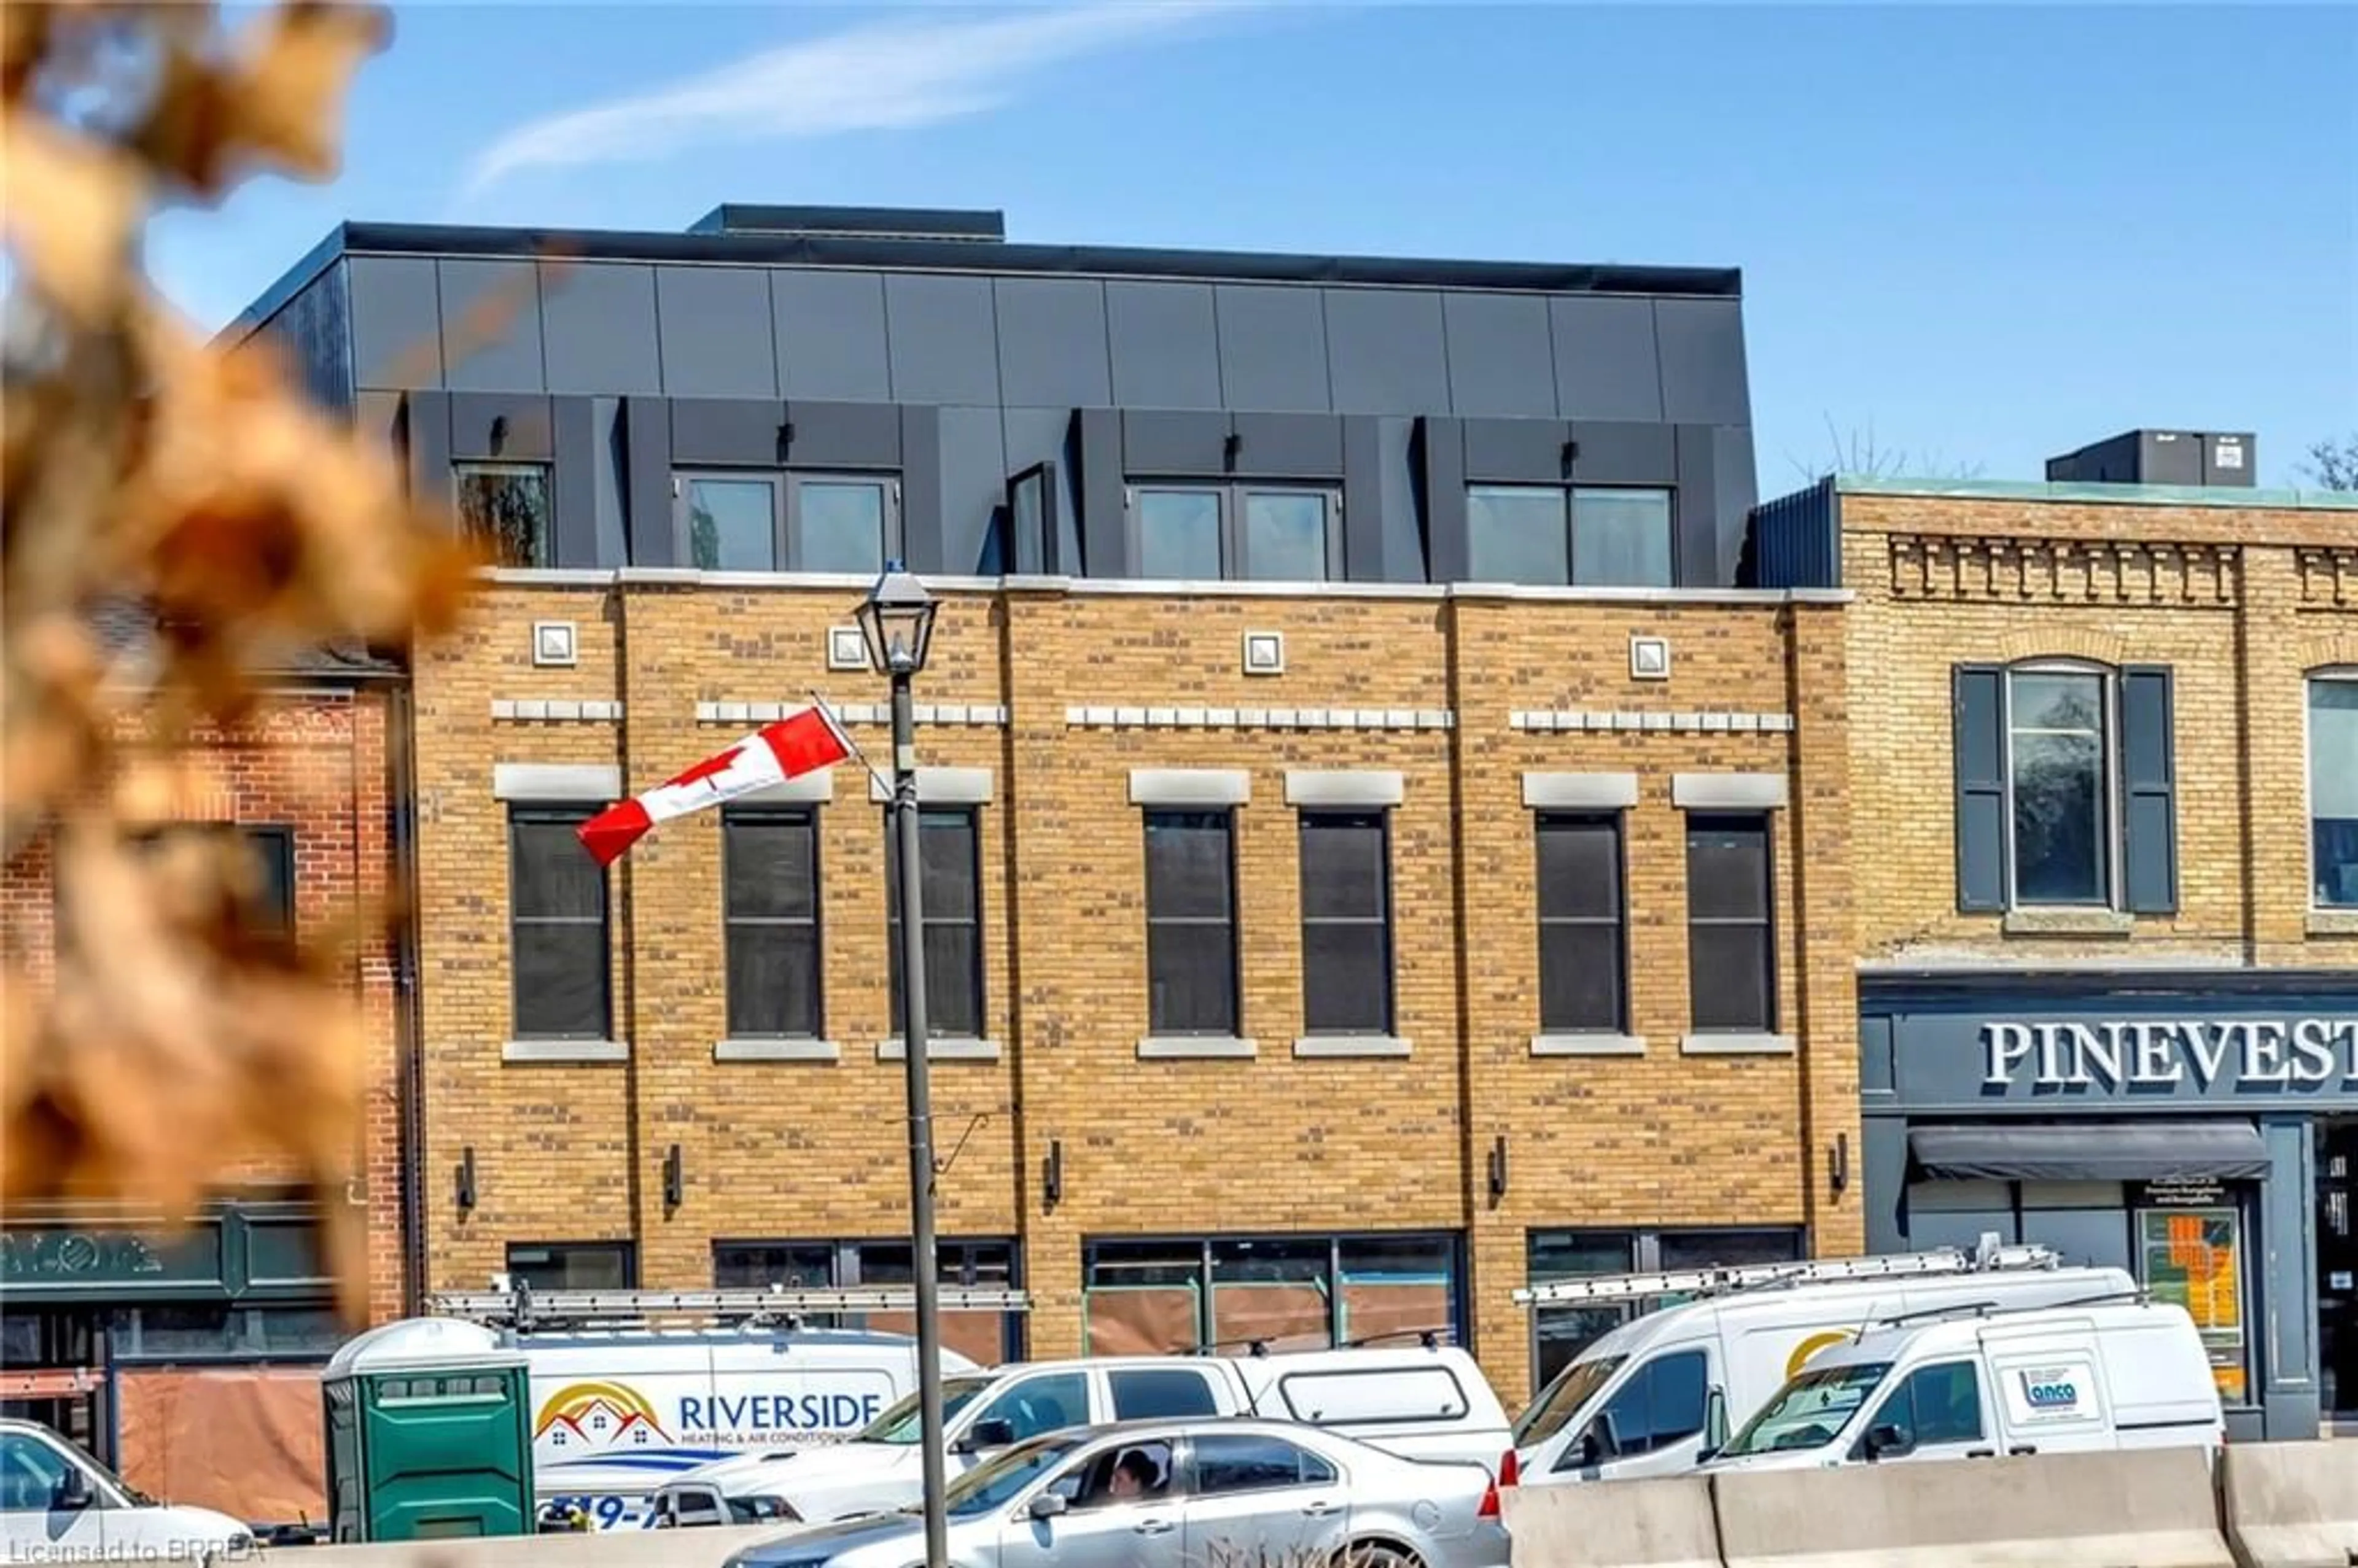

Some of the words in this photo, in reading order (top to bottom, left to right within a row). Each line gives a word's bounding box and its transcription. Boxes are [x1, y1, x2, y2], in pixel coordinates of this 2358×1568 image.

[680, 1394, 881, 1429] RIVERSIDE
[682, 1432, 733, 1443] HEATING
[737, 1432, 744, 1443] &
[749, 1431, 766, 1443] AIR
